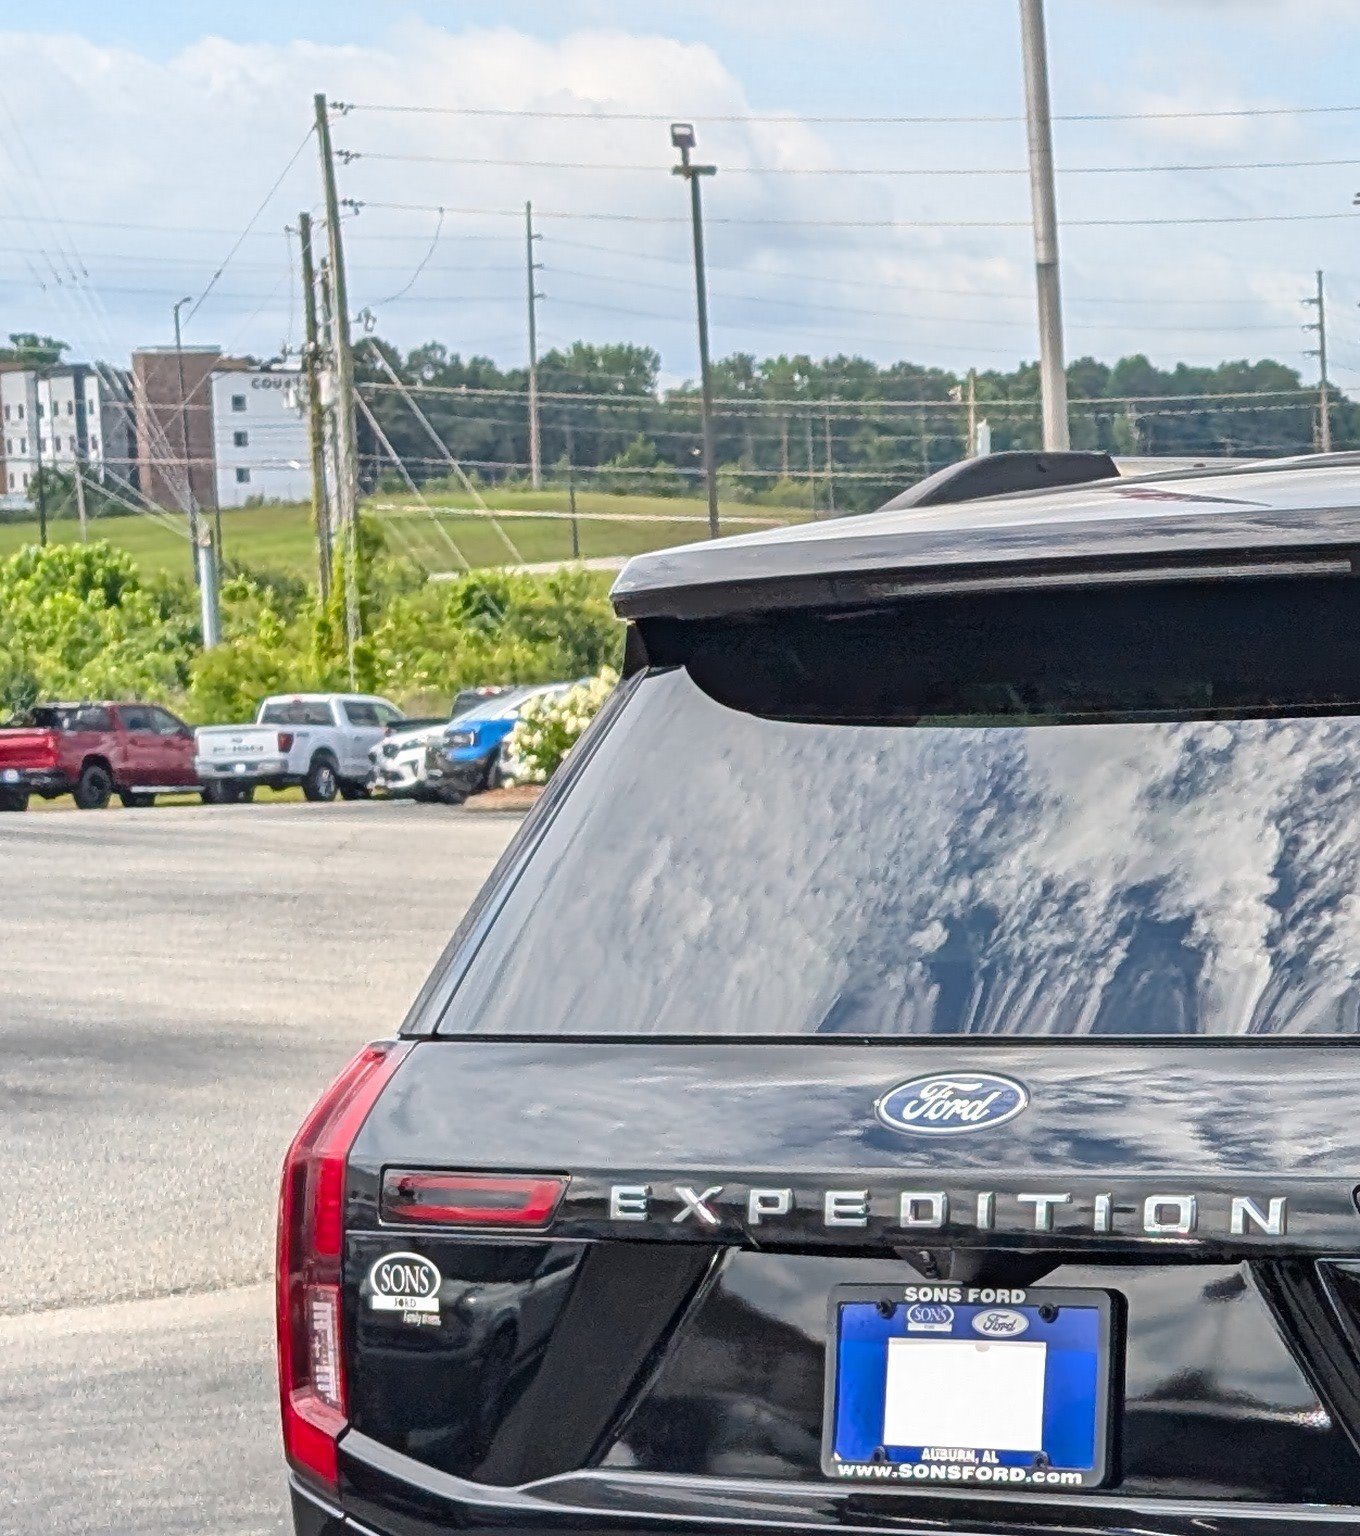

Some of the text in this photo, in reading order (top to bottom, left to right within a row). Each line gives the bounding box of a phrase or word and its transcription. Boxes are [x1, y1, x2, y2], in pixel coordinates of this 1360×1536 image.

[902, 1081, 1003, 1121] Ford
[610, 1184, 1288, 1235] EXPEDITION
[381, 1264, 429, 1294] SONS
[904, 1286, 1026, 1304] SONS FORD
[914, 1306, 948, 1321] SONS
[982, 1312, 1019, 1332] Ford
[982, 1449, 999, 1463] AL
[838, 1464, 1082, 1484] www.SONSFORD.com
